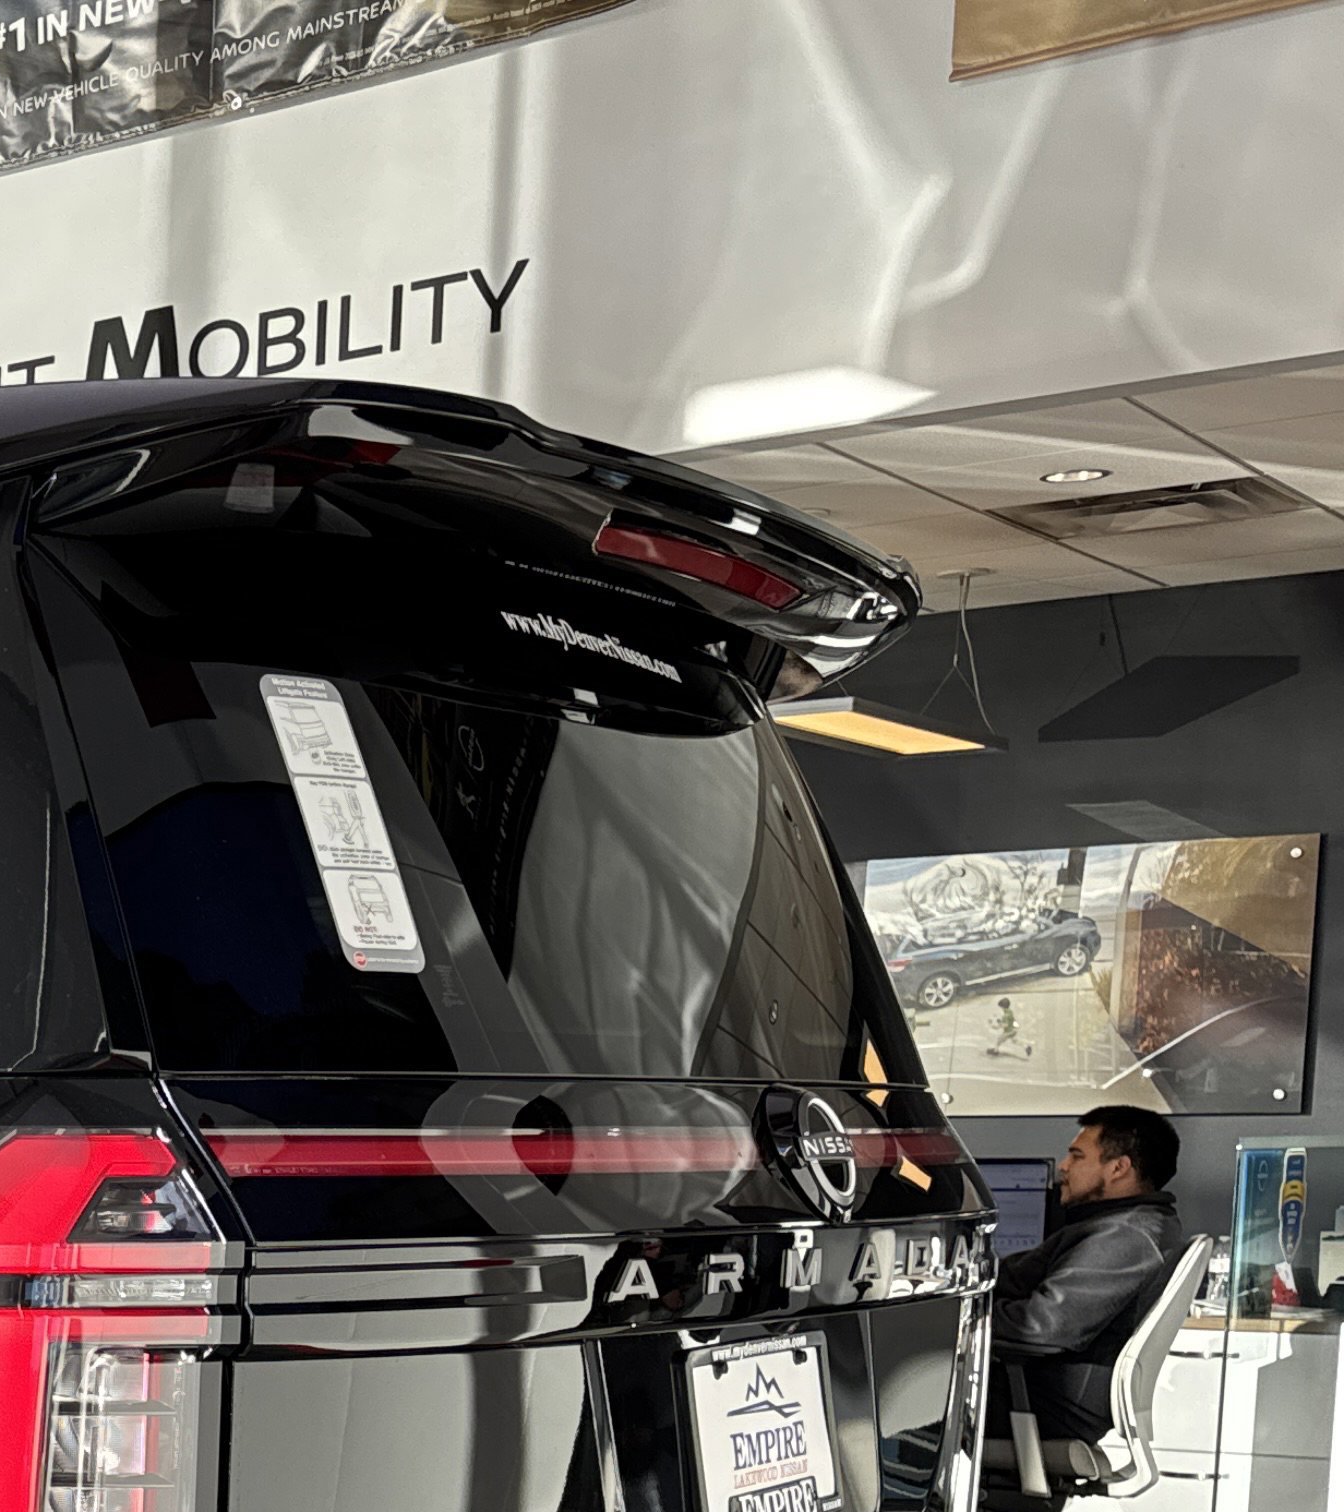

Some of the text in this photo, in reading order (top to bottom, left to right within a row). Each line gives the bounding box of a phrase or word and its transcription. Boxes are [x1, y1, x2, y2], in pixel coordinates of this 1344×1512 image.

[36, 10, 68, 45] IN
[13, 73, 119, 118] NEW-VEHICLE
[126, 50, 204, 83] QUALITY
[210, 31, 281, 62] AMONG
[86, 258, 529, 379] MOBILITY
[608, 1234, 972, 1302] ARMADA
[730, 1420, 807, 1471] EMPIRE
